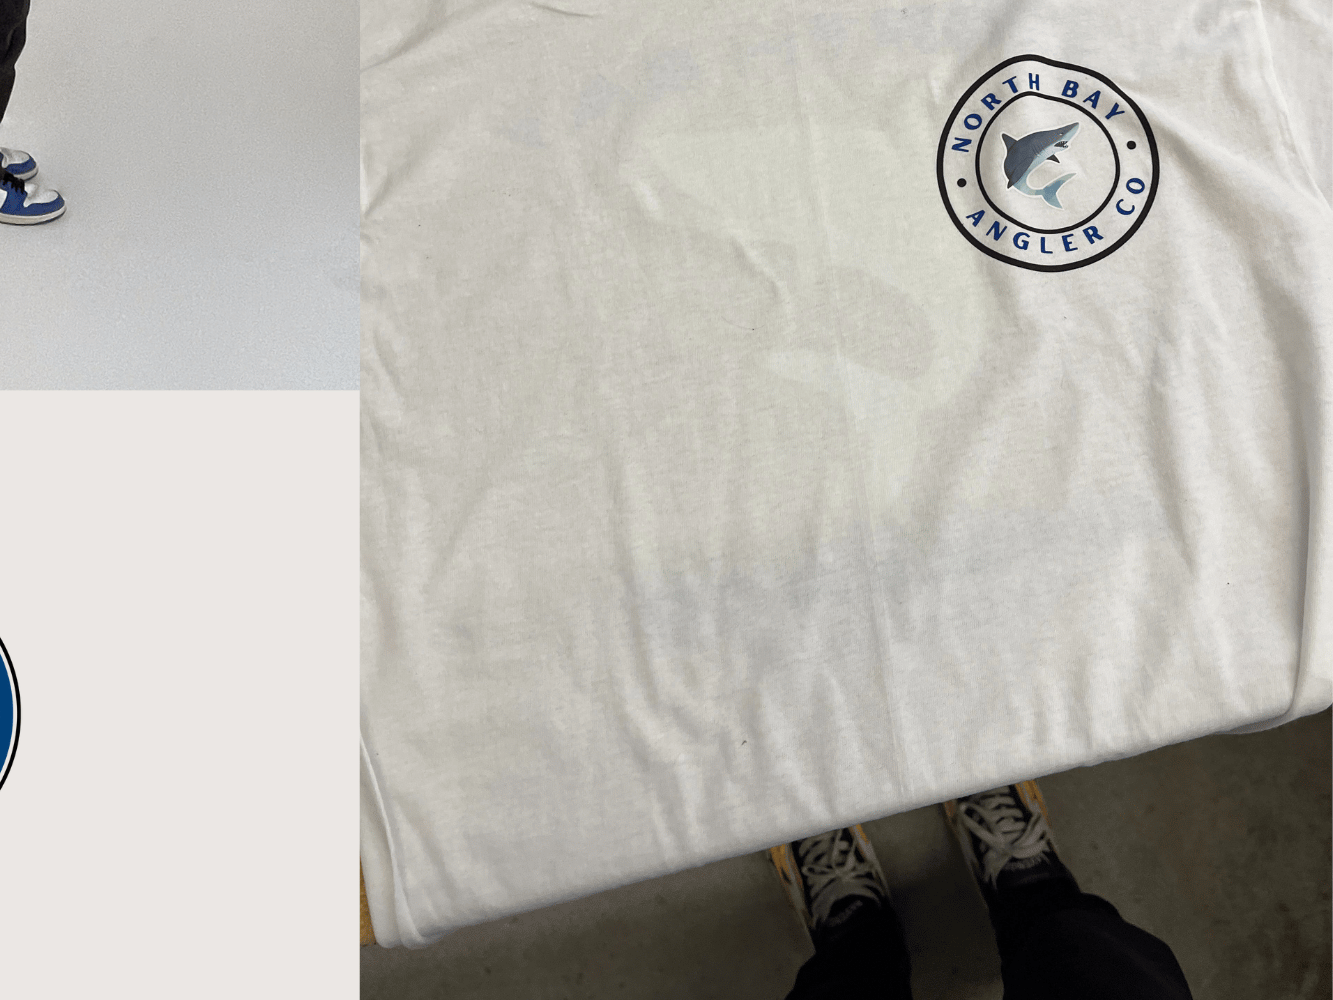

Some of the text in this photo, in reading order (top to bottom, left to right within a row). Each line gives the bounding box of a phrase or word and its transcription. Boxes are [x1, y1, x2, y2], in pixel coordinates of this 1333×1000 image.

[951, 72, 1126, 153] NORTH BAY
[965, 177, 1146, 255] ANGLER CO
